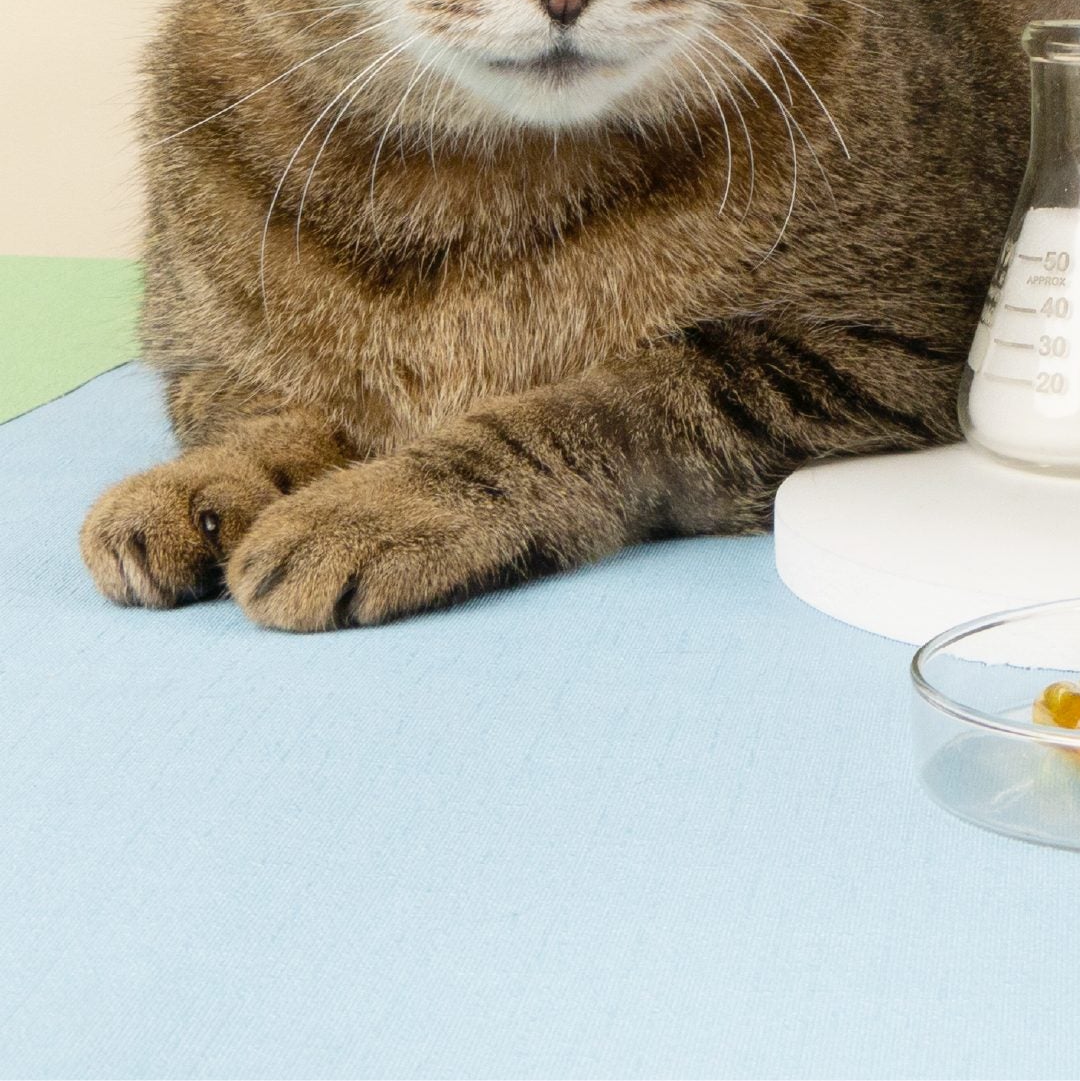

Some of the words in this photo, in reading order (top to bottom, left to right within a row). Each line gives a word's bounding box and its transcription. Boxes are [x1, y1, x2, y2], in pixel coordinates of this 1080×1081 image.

[1043, 251, 1070, 272] 50
[1026, 276, 1066, 287] APPROX
[1040, 297, 1069, 319] 40
[1039, 335, 1067, 357] 30
[1036, 372, 1064, 394] 20
